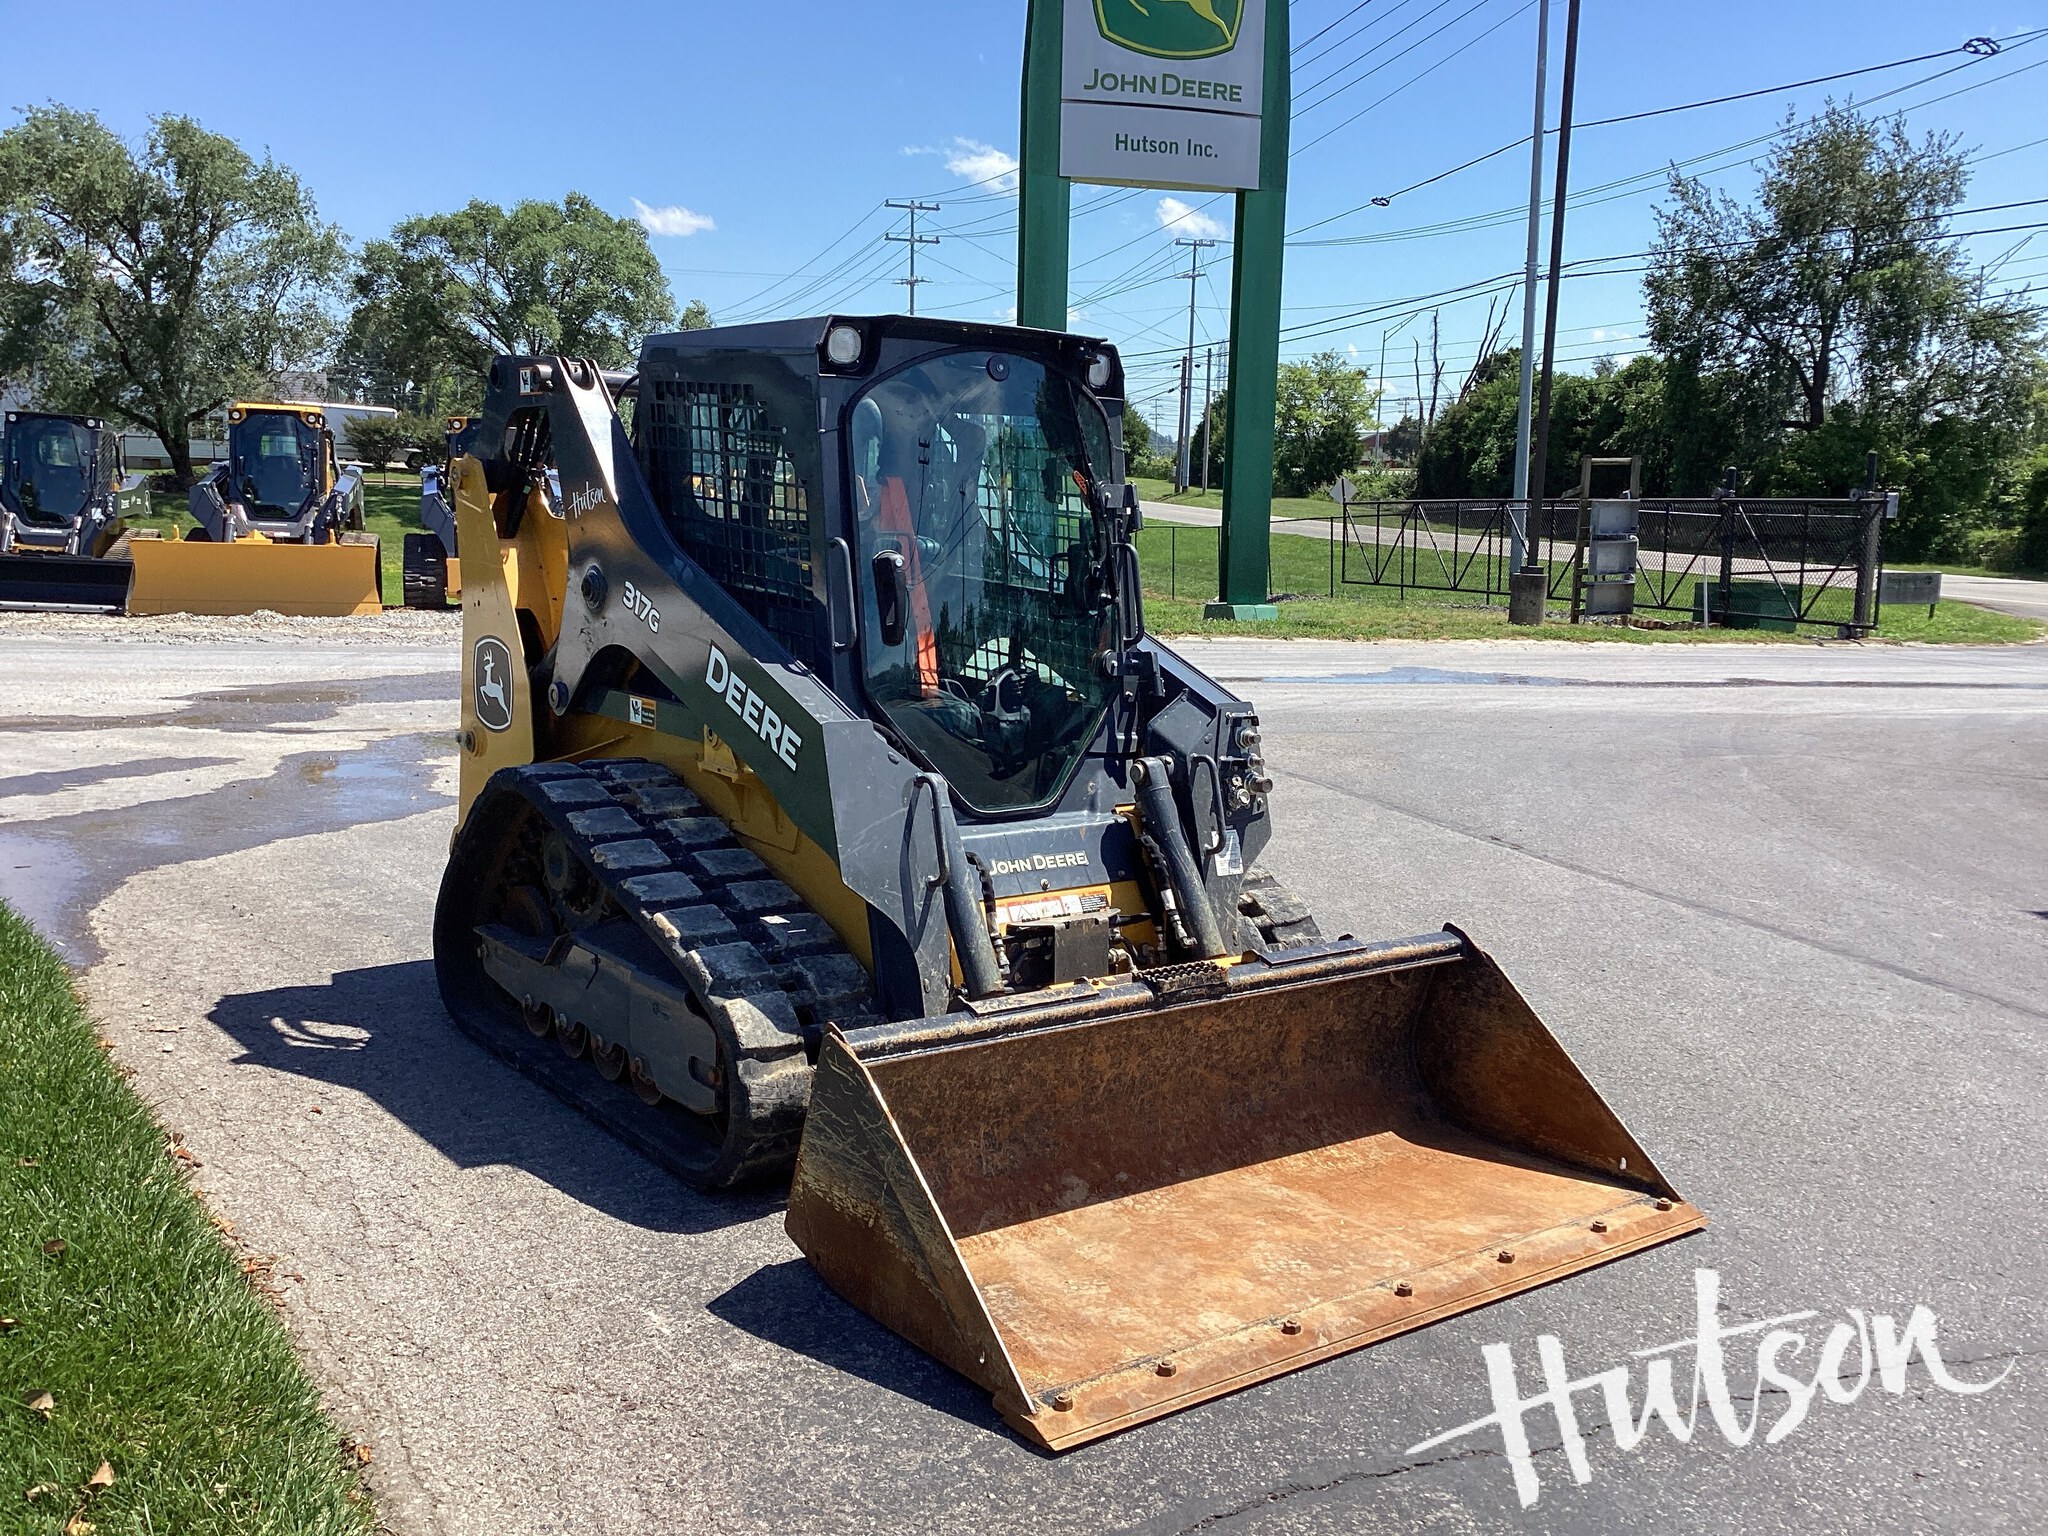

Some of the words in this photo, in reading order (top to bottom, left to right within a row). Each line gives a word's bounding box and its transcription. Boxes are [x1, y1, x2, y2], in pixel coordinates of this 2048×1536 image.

[1083, 68, 1157, 95] JOHN
[1162, 73, 1243, 103] DEERE
[1115, 133, 1179, 155] Hutson
[1187, 139, 1219, 159] Inc.
[568, 481, 607, 519] Hutson
[622, 581, 660, 634] 317G
[705, 642, 803, 772] DEERE
[989, 858, 1032, 876] JOHN
[1032, 851, 1087, 870] DEERE
